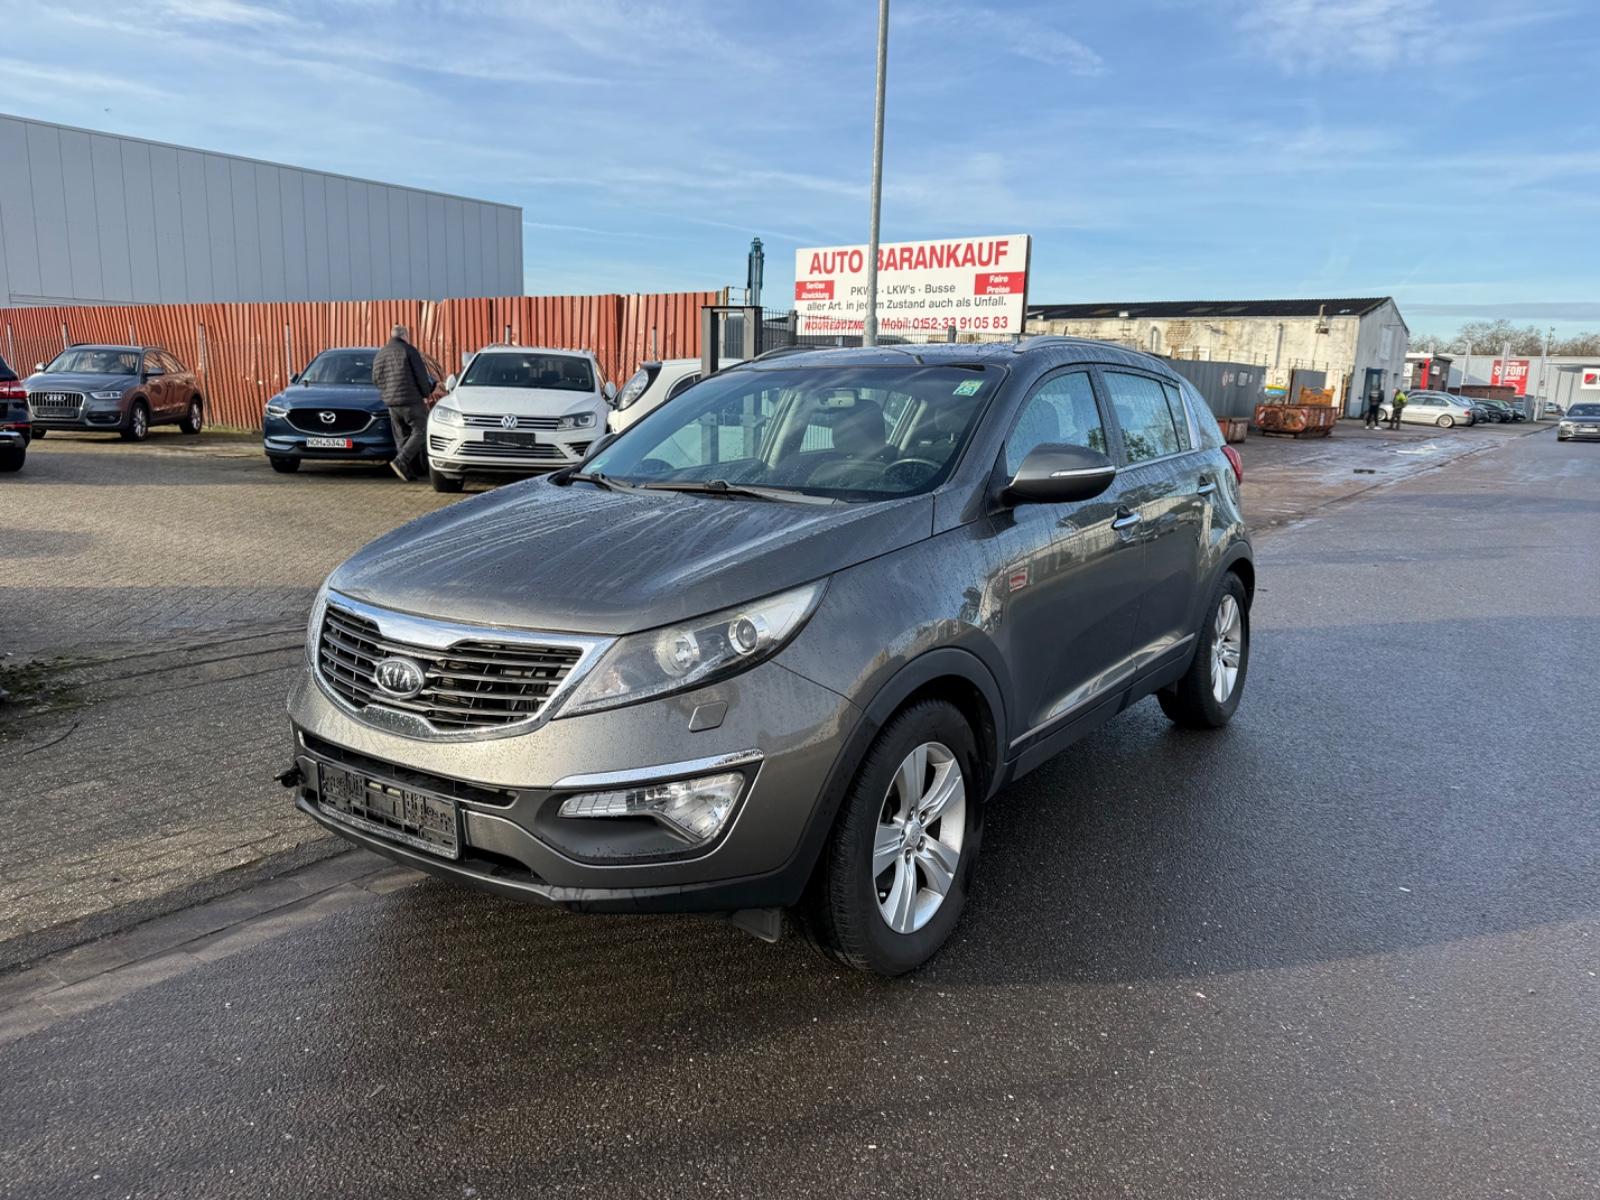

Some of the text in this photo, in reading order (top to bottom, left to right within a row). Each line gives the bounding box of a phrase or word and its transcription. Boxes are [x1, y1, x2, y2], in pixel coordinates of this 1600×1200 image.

[809, 249, 863, 275] AUTO
[887, 285, 916, 295] LKW's
[925, 284, 956, 294] Busse
[807, 301, 826, 311] aller
[846, 301, 854, 310] in
[887, 298, 925, 308] Zustand
[928, 298, 953, 309] auch
[956, 297, 971, 308] als
[974, 296, 1007, 307] Unfall.
[992, 316, 1008, 329] 83
[1493, 365, 1527, 376] SFORT
[381, 665, 412, 691] KIA
